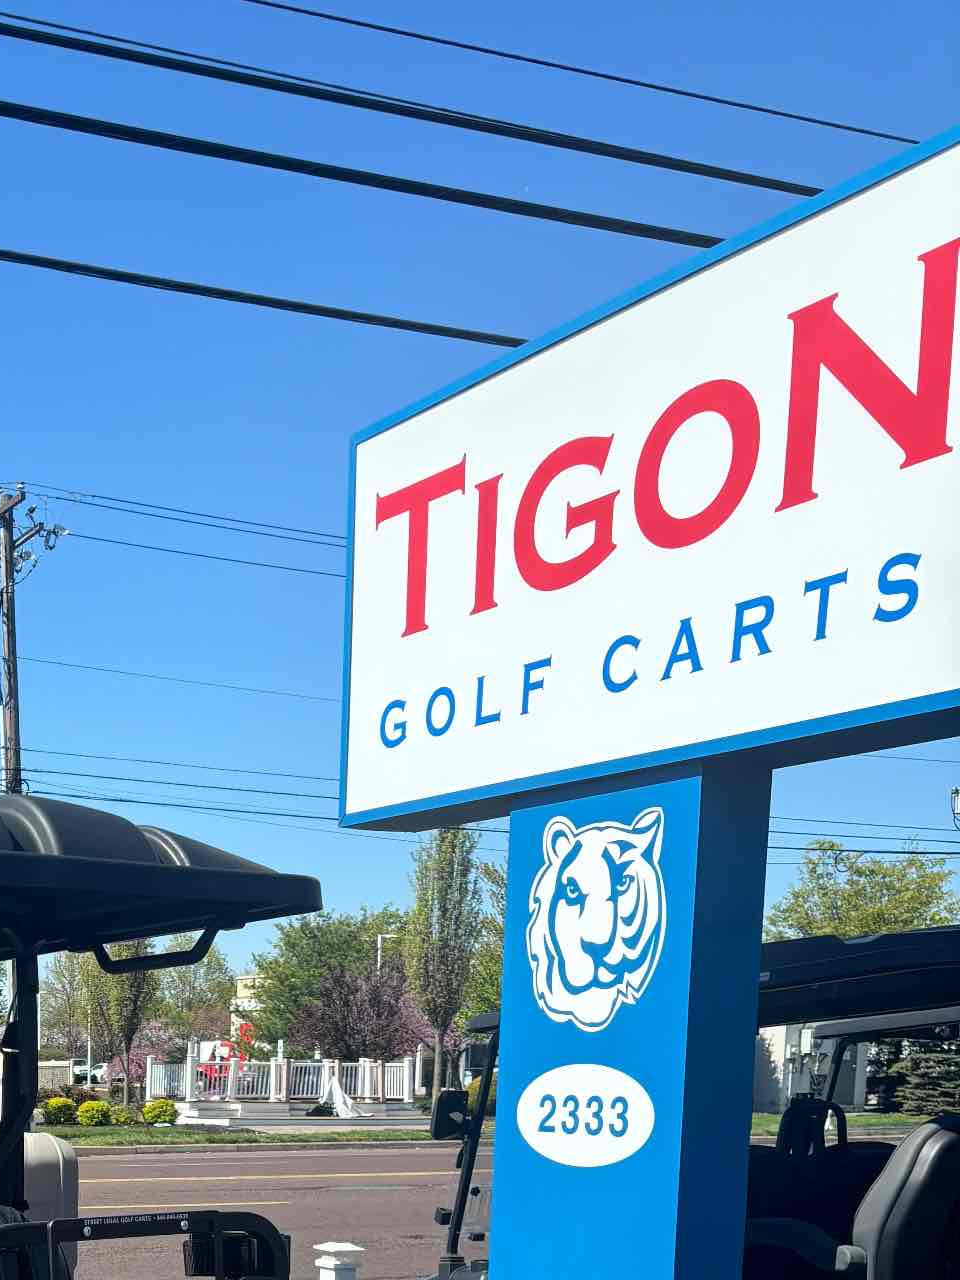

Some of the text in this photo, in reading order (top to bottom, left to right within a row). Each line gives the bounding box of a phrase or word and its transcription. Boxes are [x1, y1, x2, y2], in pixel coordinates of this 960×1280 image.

[375, 236, 960, 637] TIGON
[379, 552, 922, 749] GOLF CARTS
[538, 1094, 629, 1138] 2333
